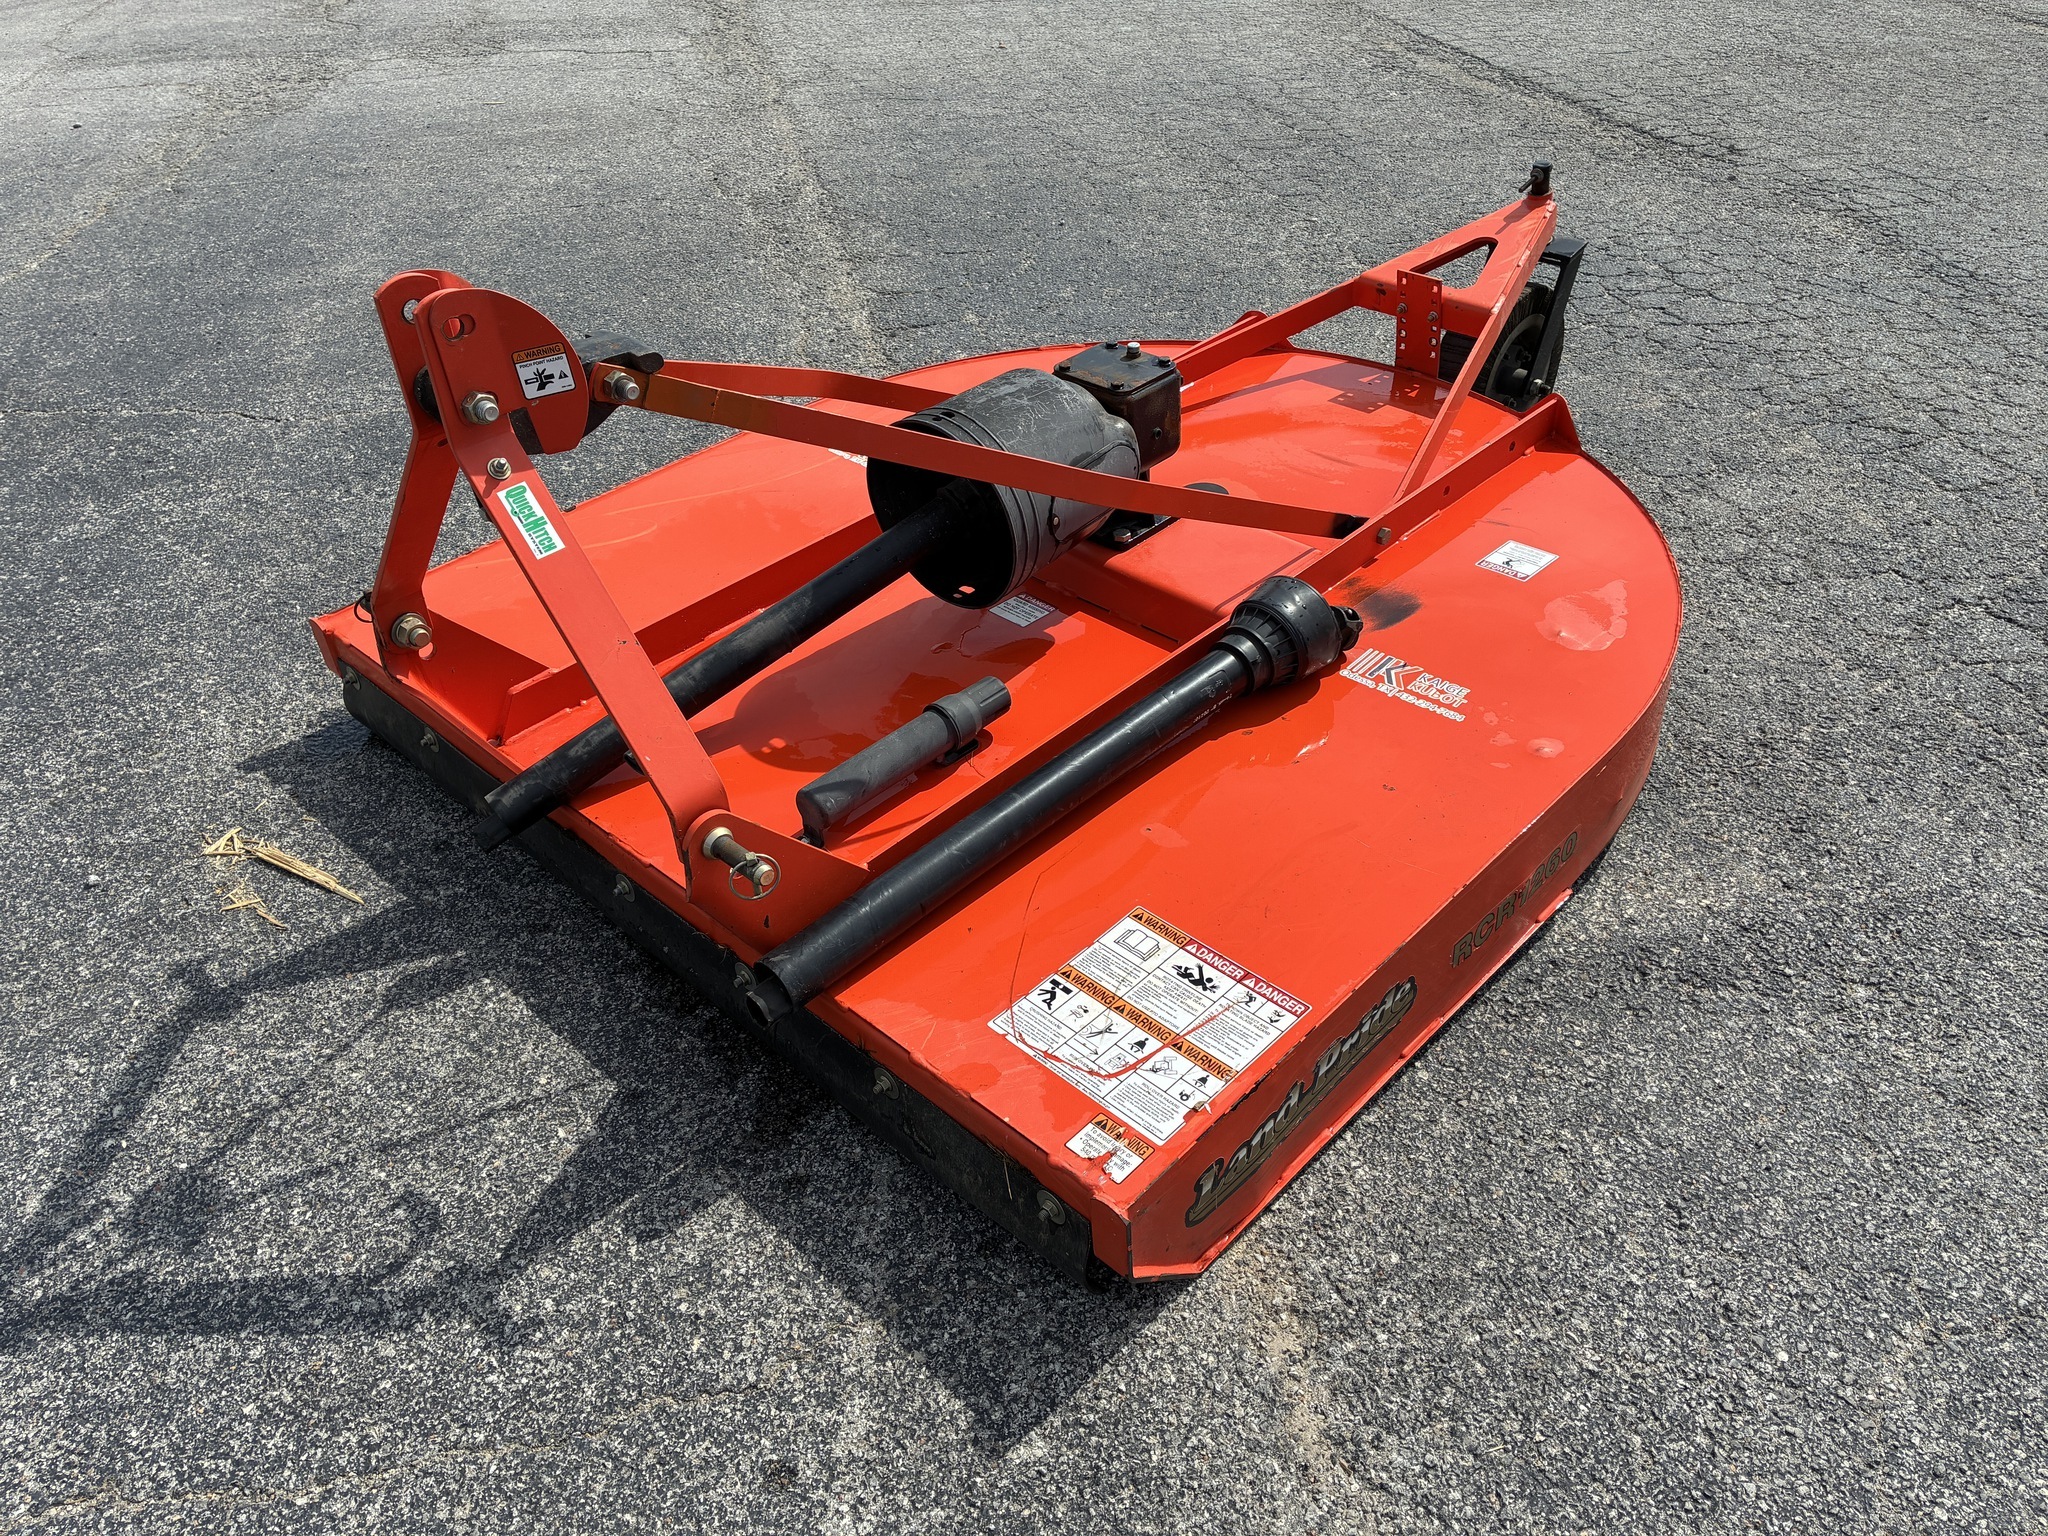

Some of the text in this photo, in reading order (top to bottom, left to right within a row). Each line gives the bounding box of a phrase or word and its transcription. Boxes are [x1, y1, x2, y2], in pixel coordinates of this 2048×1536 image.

[524, 345, 560, 359] WARNING
[1480, 560, 1517, 576] DANGER
[1026, 595, 1055, 611] DANGER
[1418, 673, 1470, 698] KAIGE
[1452, 831, 1578, 967] RCR1260
[1141, 916, 1188, 945] WARNING
[1195, 948, 1245, 979] DANGER
[1069, 973, 1116, 1005] WARNING
[1253, 982, 1305, 1015] DANGER
[1123, 1008, 1172, 1041] WARNING
[1181, 1045, 1231, 1079] WARNING
[1191, 1080, 1304, 1212] Land
[1314, 976, 1417, 1092] Pride
[1097, 1132, 1112, 1144] avoid
[1114, 1161, 1125, 1171] with
